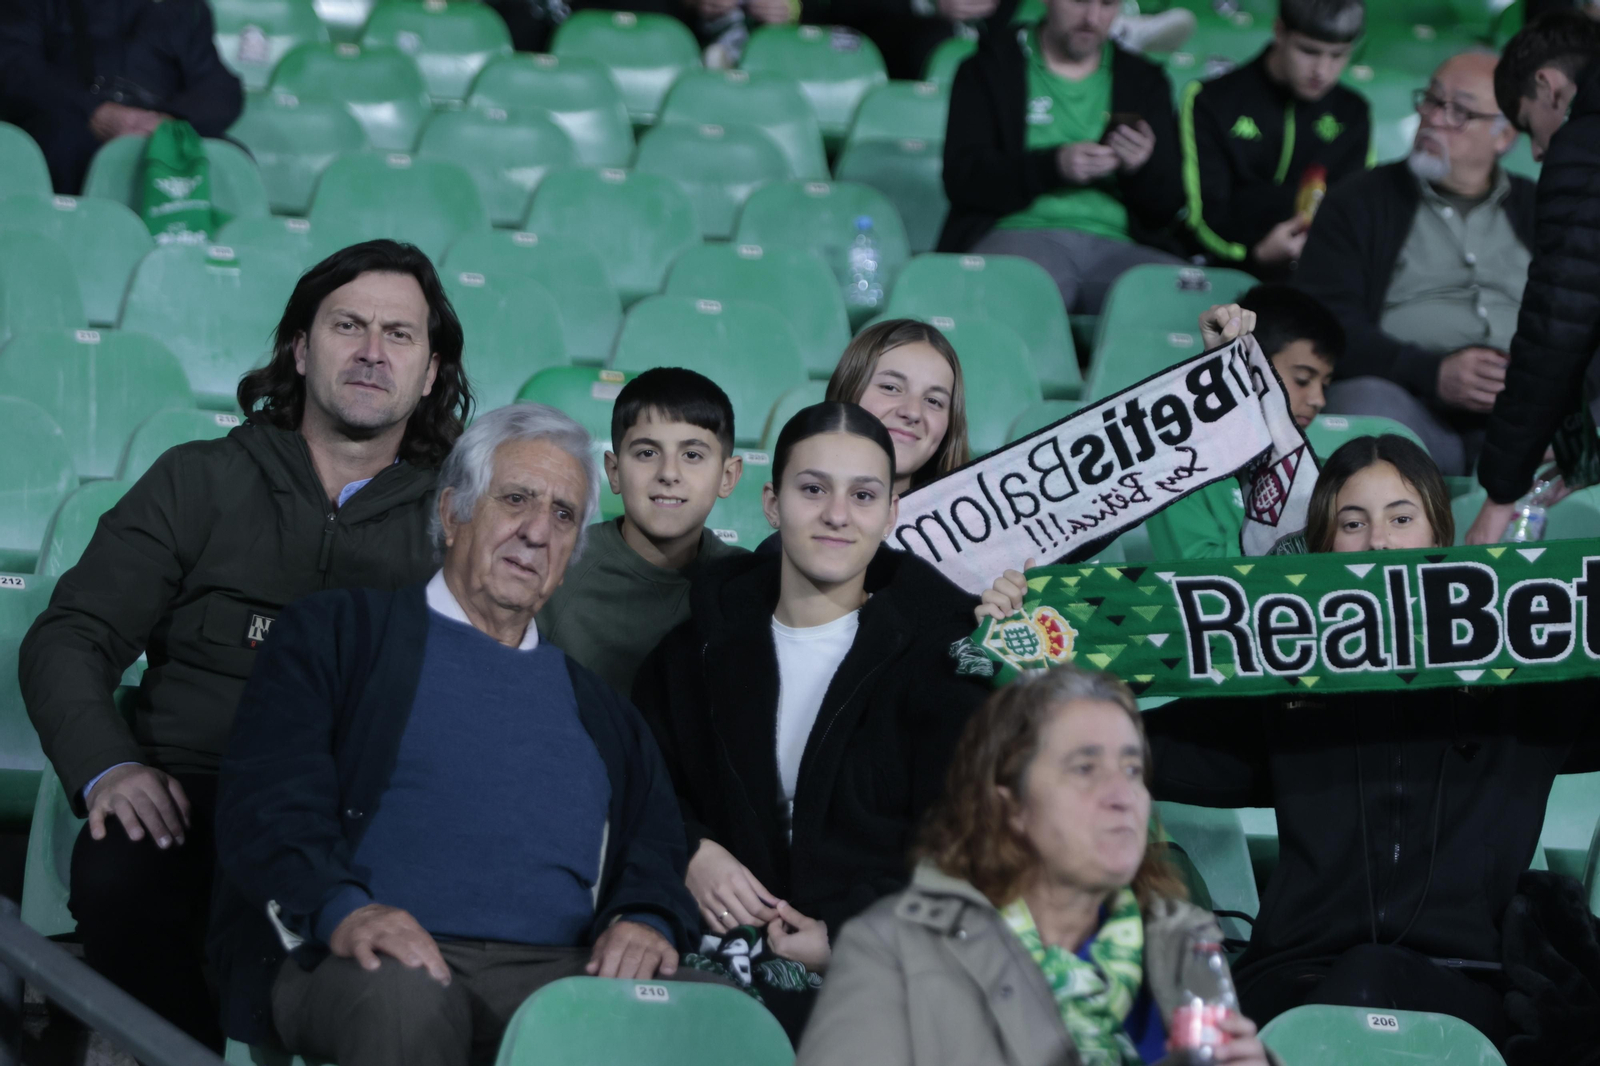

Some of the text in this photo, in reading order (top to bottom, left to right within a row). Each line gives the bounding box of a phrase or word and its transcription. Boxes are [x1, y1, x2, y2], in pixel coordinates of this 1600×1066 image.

[1, 576, 23, 586] 212
[639, 986, 665, 997] 210
[1371, 1016, 1397, 1027] 206
